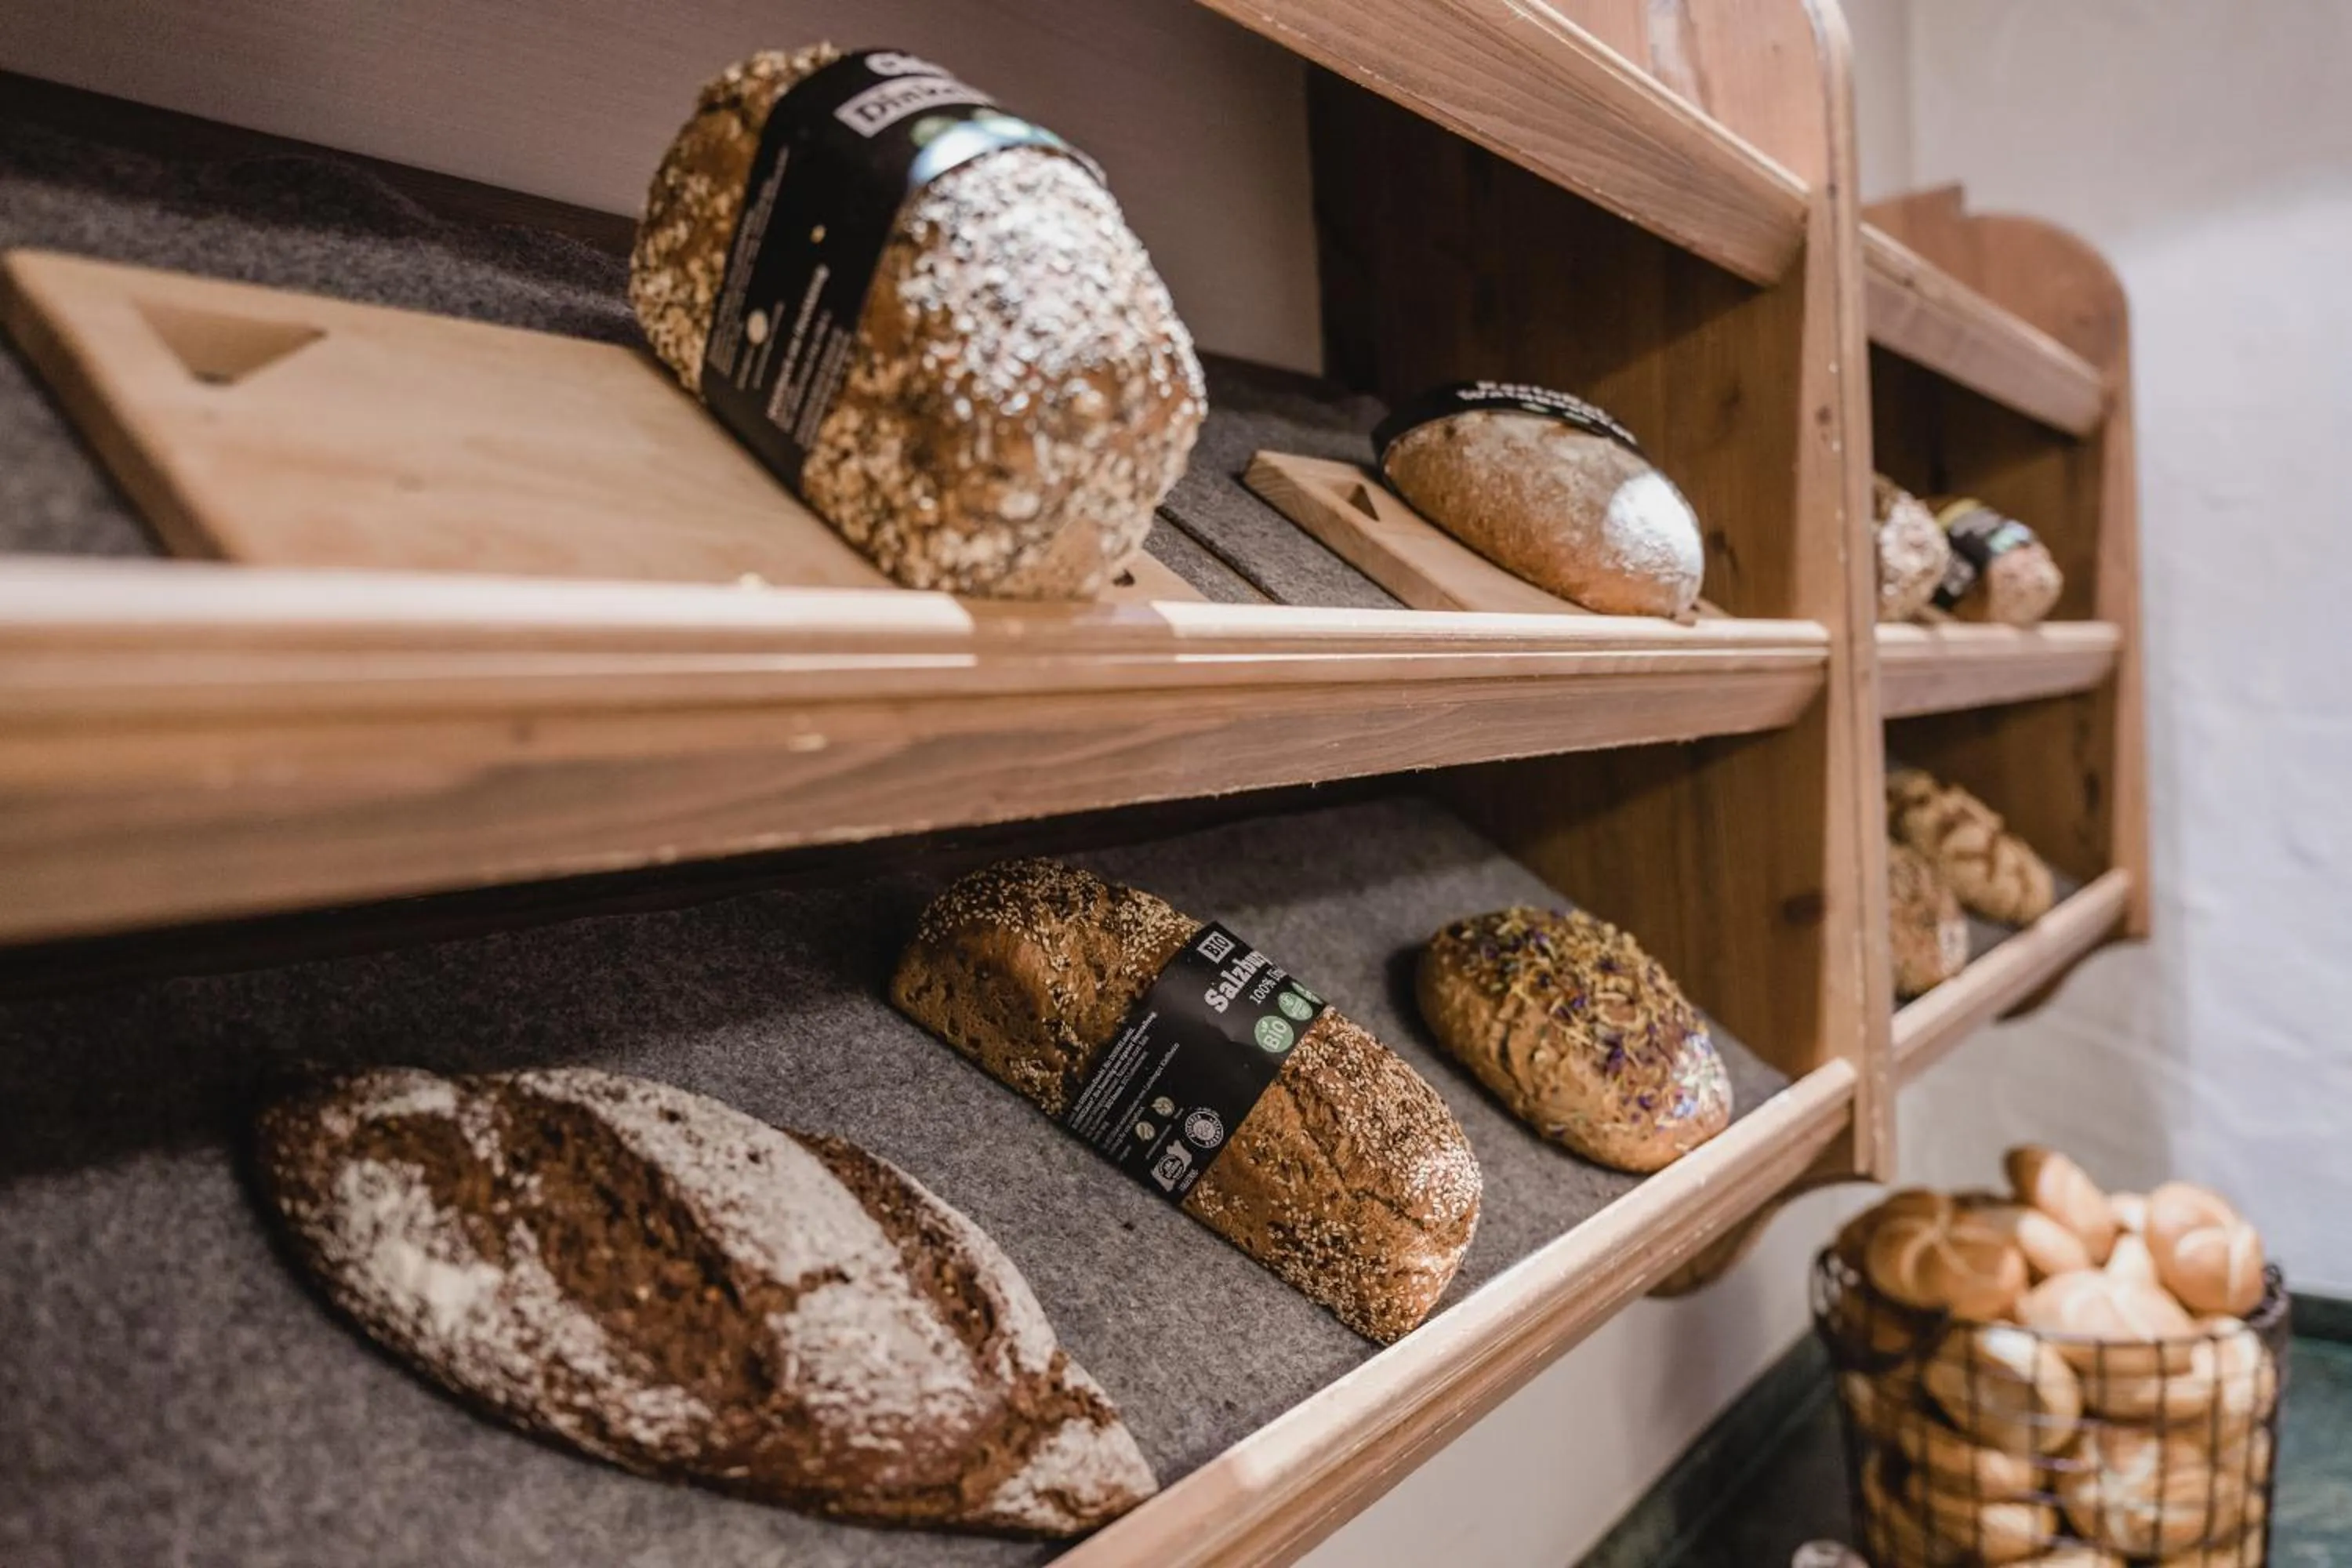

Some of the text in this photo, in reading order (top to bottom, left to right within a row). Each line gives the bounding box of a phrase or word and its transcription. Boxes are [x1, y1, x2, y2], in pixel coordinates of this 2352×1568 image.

[1204, 935, 1228, 957] BIO
[1249, 977, 1277, 1005] 100%
[1264, 1020, 1288, 1050] BIO
